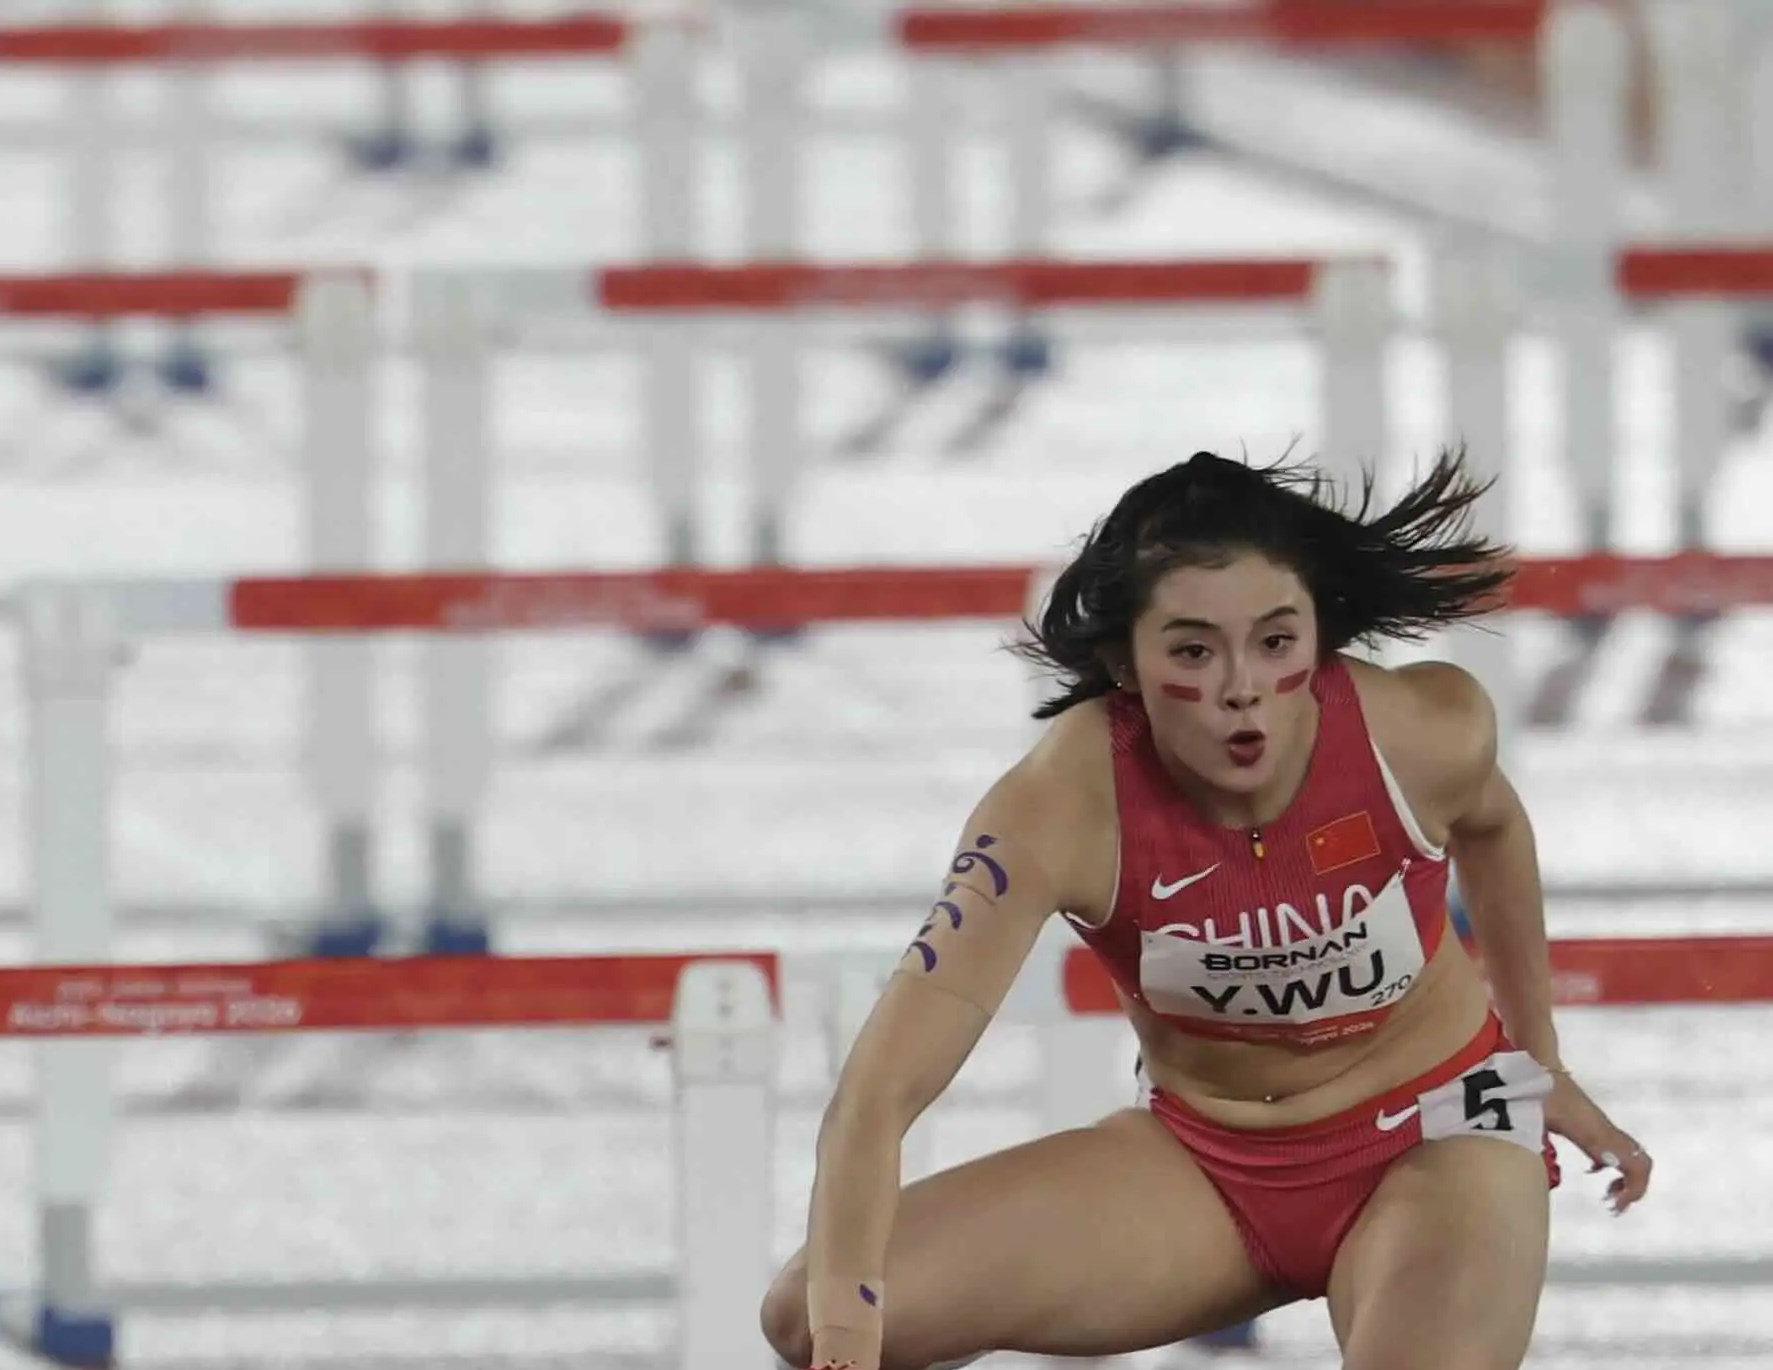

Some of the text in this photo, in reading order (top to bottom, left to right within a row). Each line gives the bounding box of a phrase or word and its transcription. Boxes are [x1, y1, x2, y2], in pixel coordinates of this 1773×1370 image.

[1153, 884, 1374, 948] HINA
[1200, 922, 1368, 971] BORNAN
[1191, 950, 1385, 1015] Y.WU
[1371, 974, 1413, 1006] 270
[1461, 1069, 1514, 1131] 5
